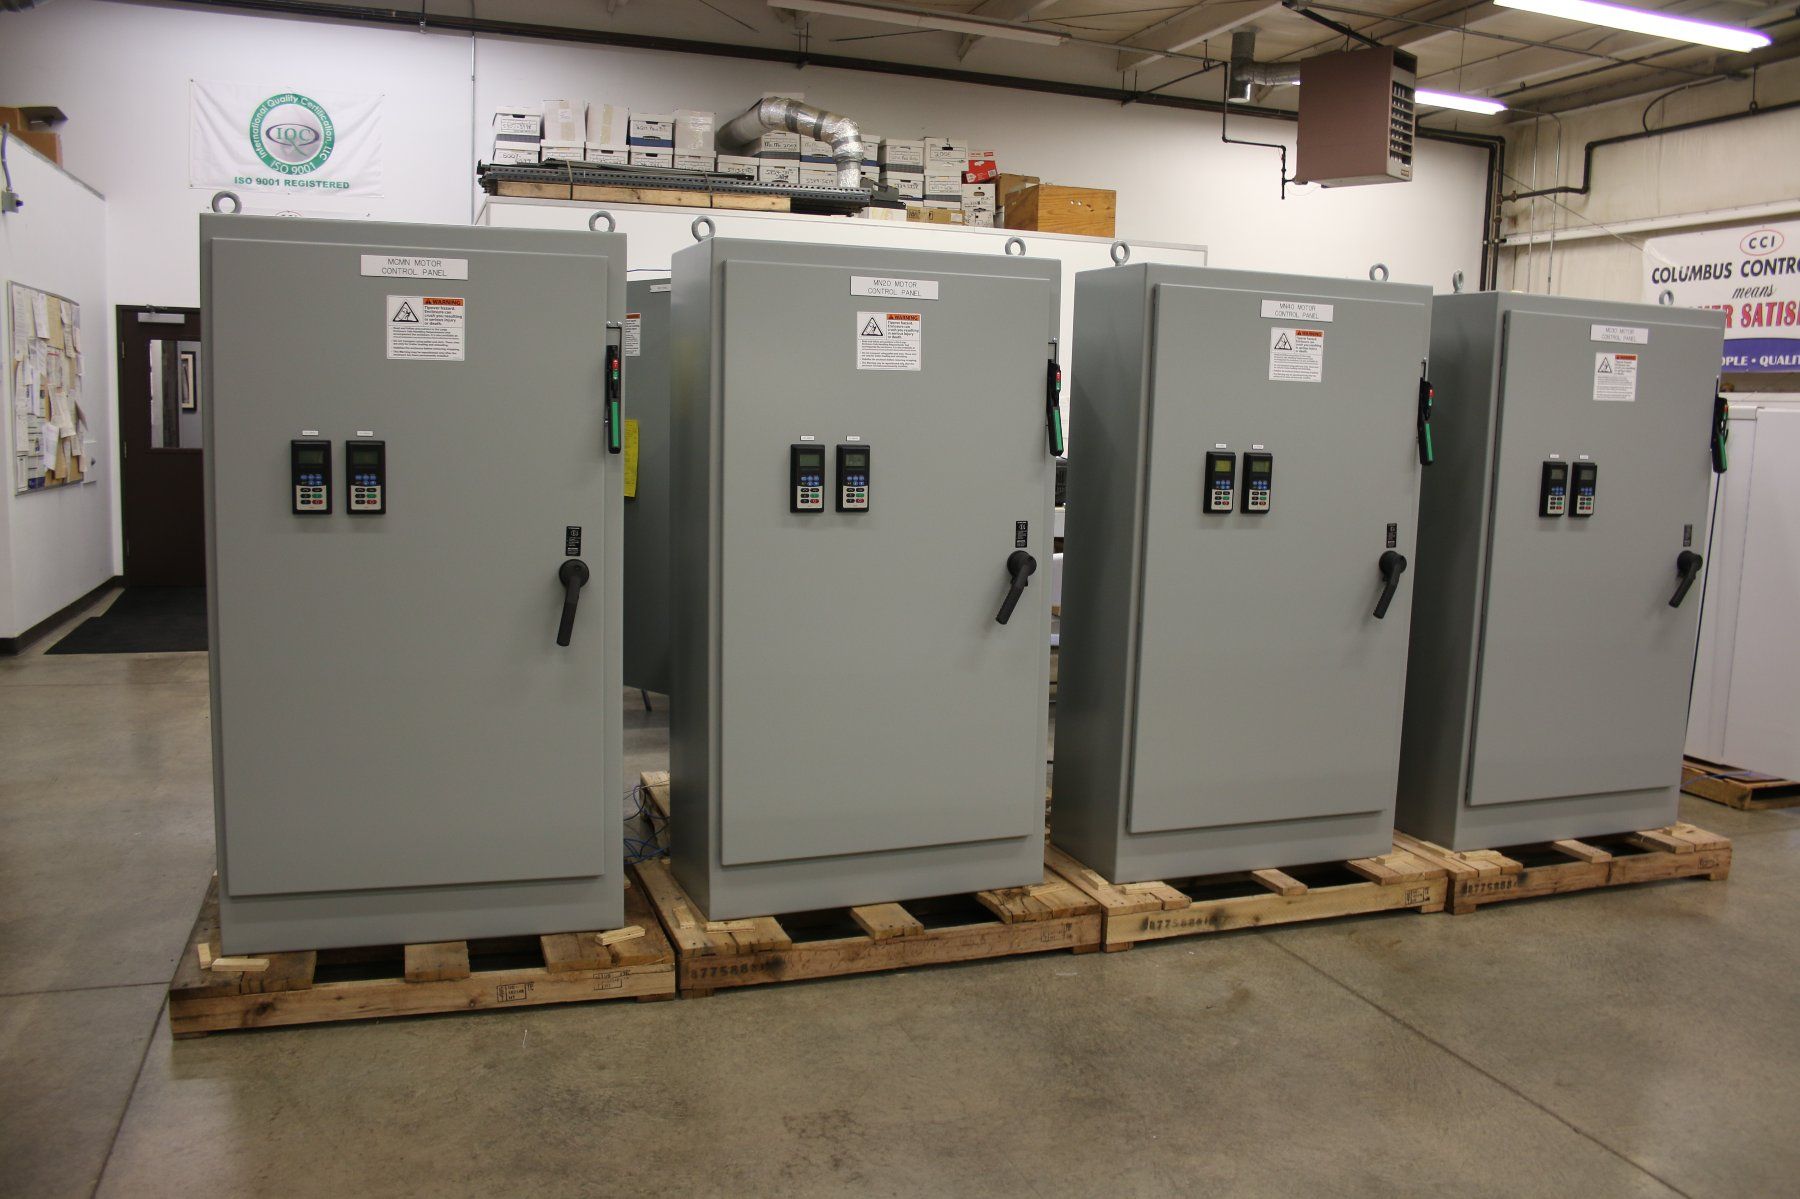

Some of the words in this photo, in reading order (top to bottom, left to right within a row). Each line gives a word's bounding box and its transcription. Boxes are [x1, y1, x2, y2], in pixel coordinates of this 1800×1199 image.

[252, 104, 268, 158] International
[267, 95, 299, 108] Quality
[275, 127, 314, 147] IQC
[271, 161, 288, 174] ISO
[291, 162, 316, 175] 9001
[234, 176, 253, 185] ISO
[256, 177, 280, 186] 9001
[284, 179, 350, 189] REGISTERED
[414, 260, 442, 268] MOTOR
[1651, 262, 1732, 284] COLUMBUS
[1740, 257, 1800, 278] CONTR
[381, 267, 417, 276] CONTROL
[422, 269, 447, 277] PANEL
[894, 280, 917, 288] MOTOR
[867, 287, 898, 296] CONTROL
[901, 289, 921, 297] PANEL
[1731, 284, 1777, 300] means
[1274, 310, 1299, 318] CONTROL
[1740, 301, 1800, 329] SATIS
